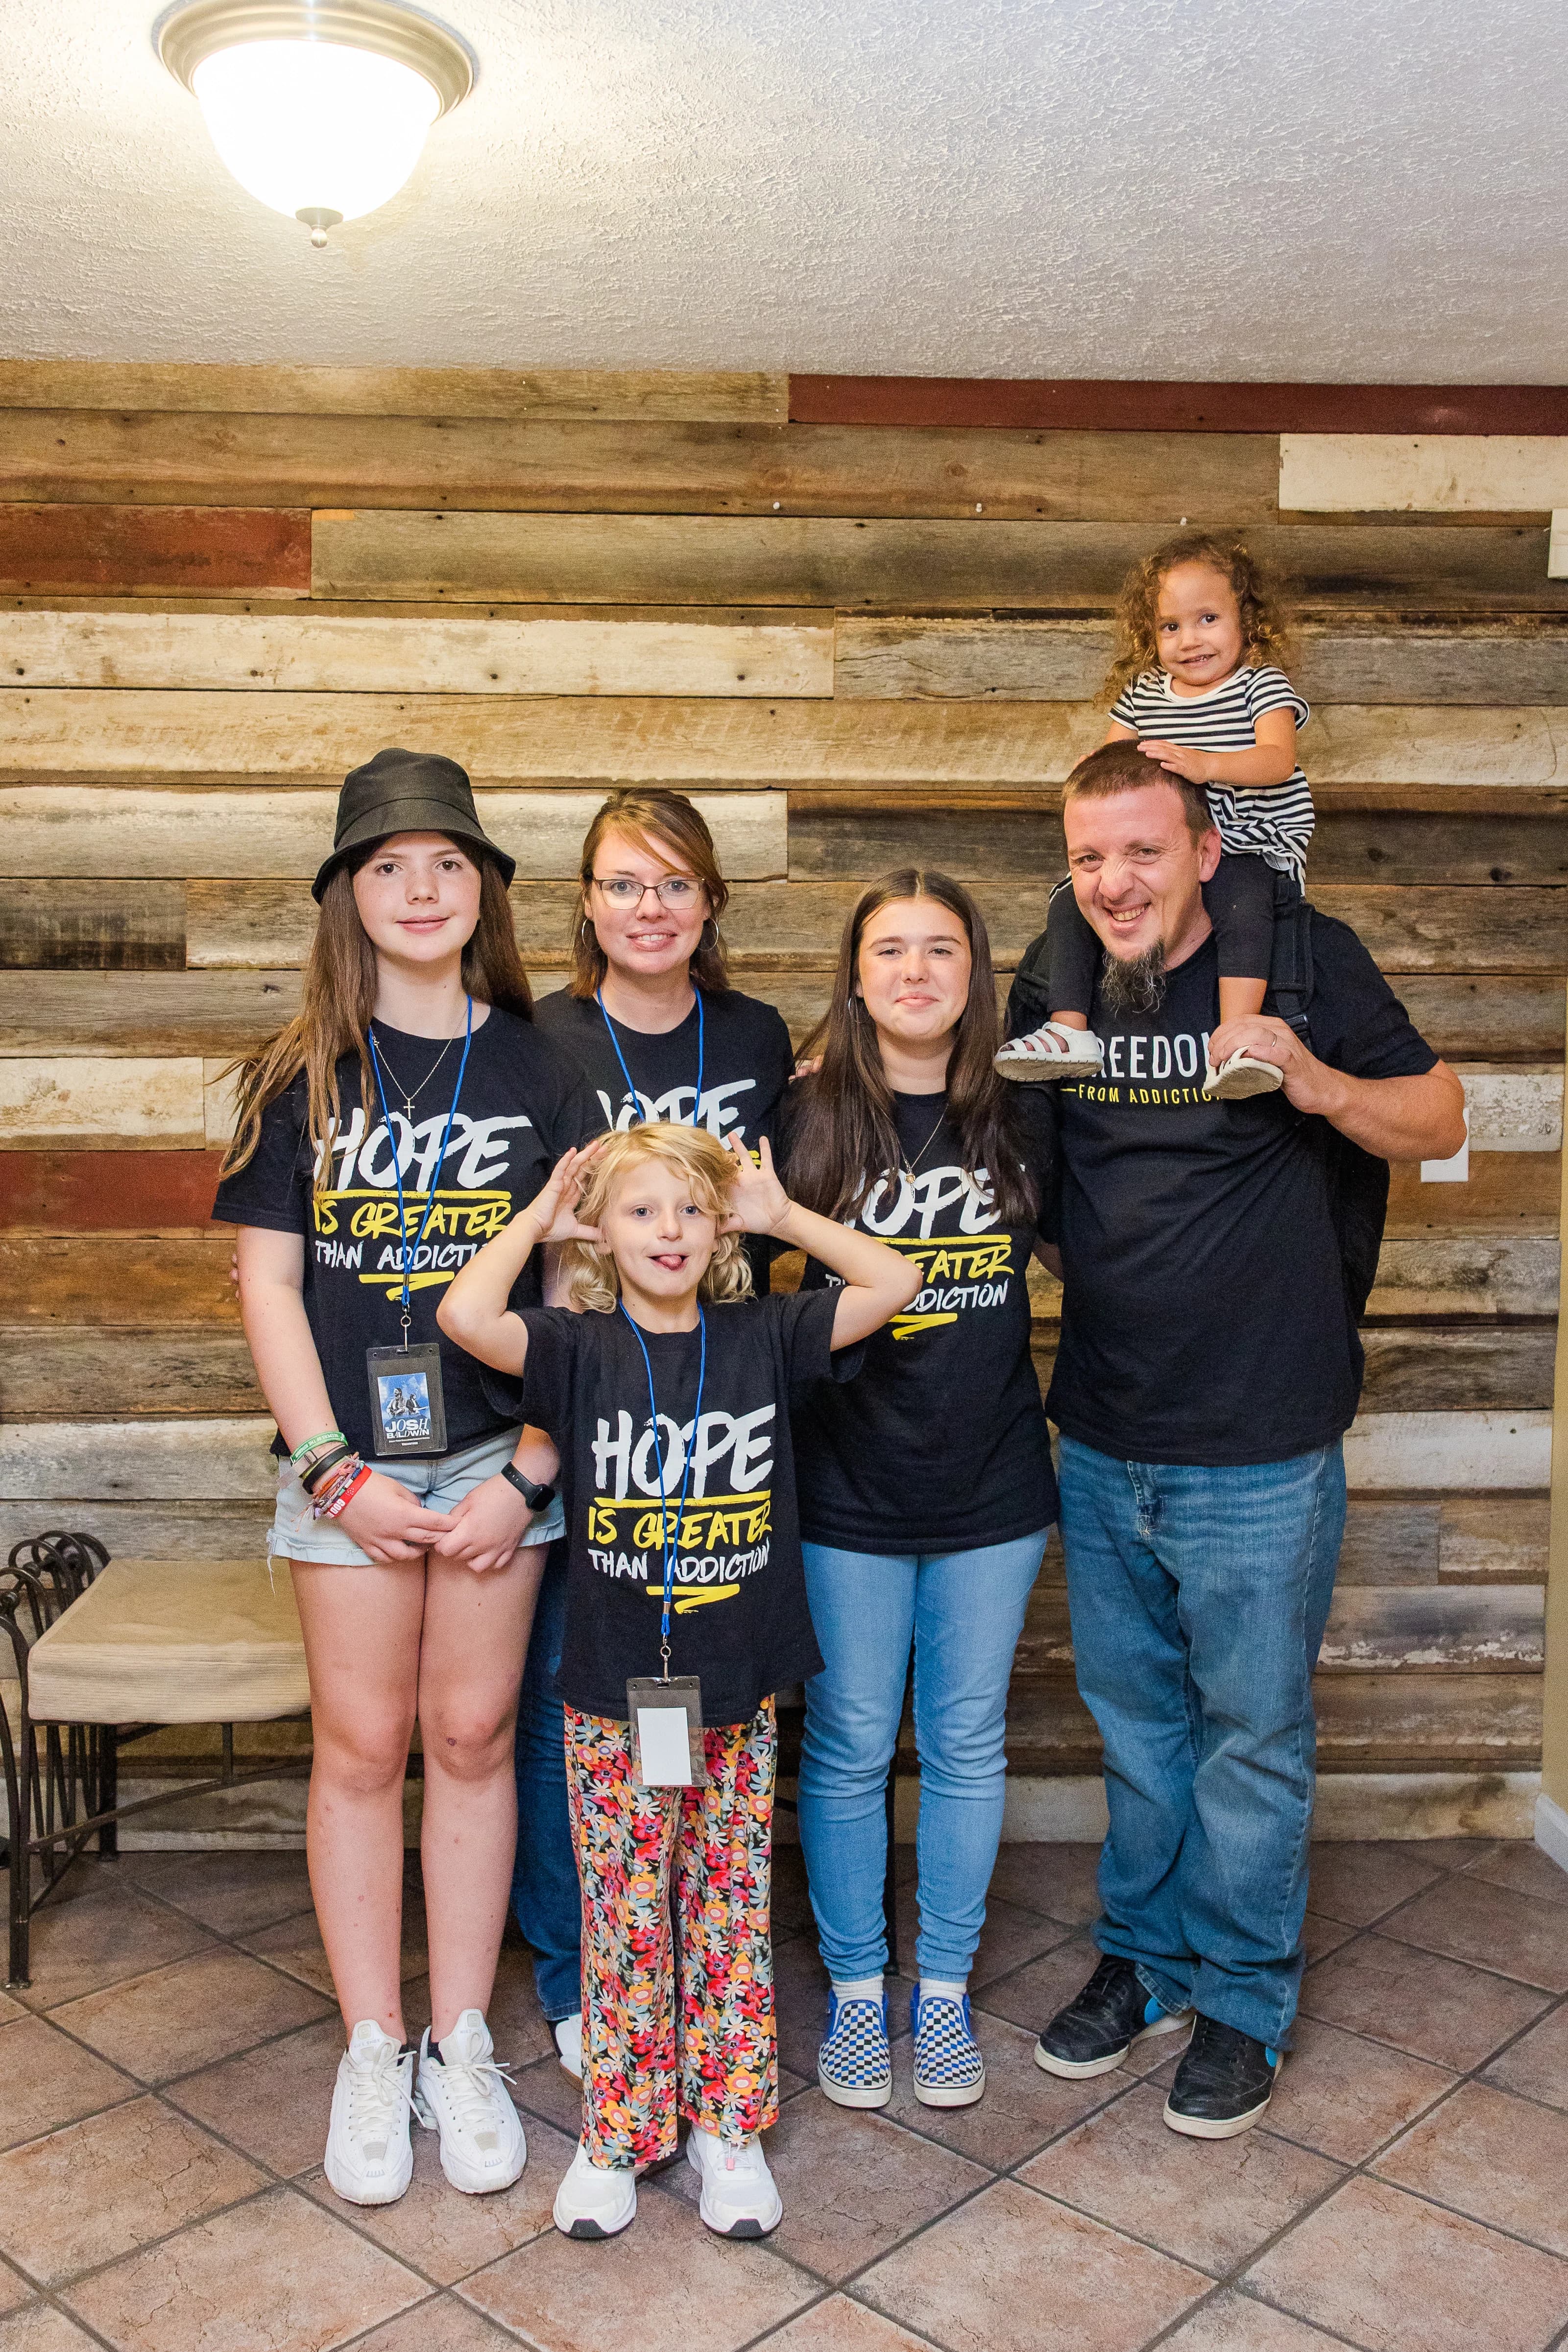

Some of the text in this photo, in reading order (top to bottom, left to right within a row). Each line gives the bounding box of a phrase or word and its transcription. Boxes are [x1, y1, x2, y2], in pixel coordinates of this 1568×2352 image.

[1091, 1032, 1210, 1079] EEDO
[1079, 1084, 1219, 1104] FROM ADDICTIO
[314, 1107, 532, 1193] HOPE
[313, 1200, 512, 1240] IS GREATER
[315, 1240, 488, 1271] THAN ADDICTI
[905, 1244, 1014, 1284] EATER
[902, 1278, 1009, 1312] DICTION
[385, 1418, 428, 1433] JOSH
[386, 1428, 430, 1439] BALDWIN
[591, 1403, 776, 1502] HOPE
[330, 1498, 345, 1514] GOD
[589, 1500, 772, 1551] IS GREATER
[588, 1536, 770, 1583] THAN ADDICTION
